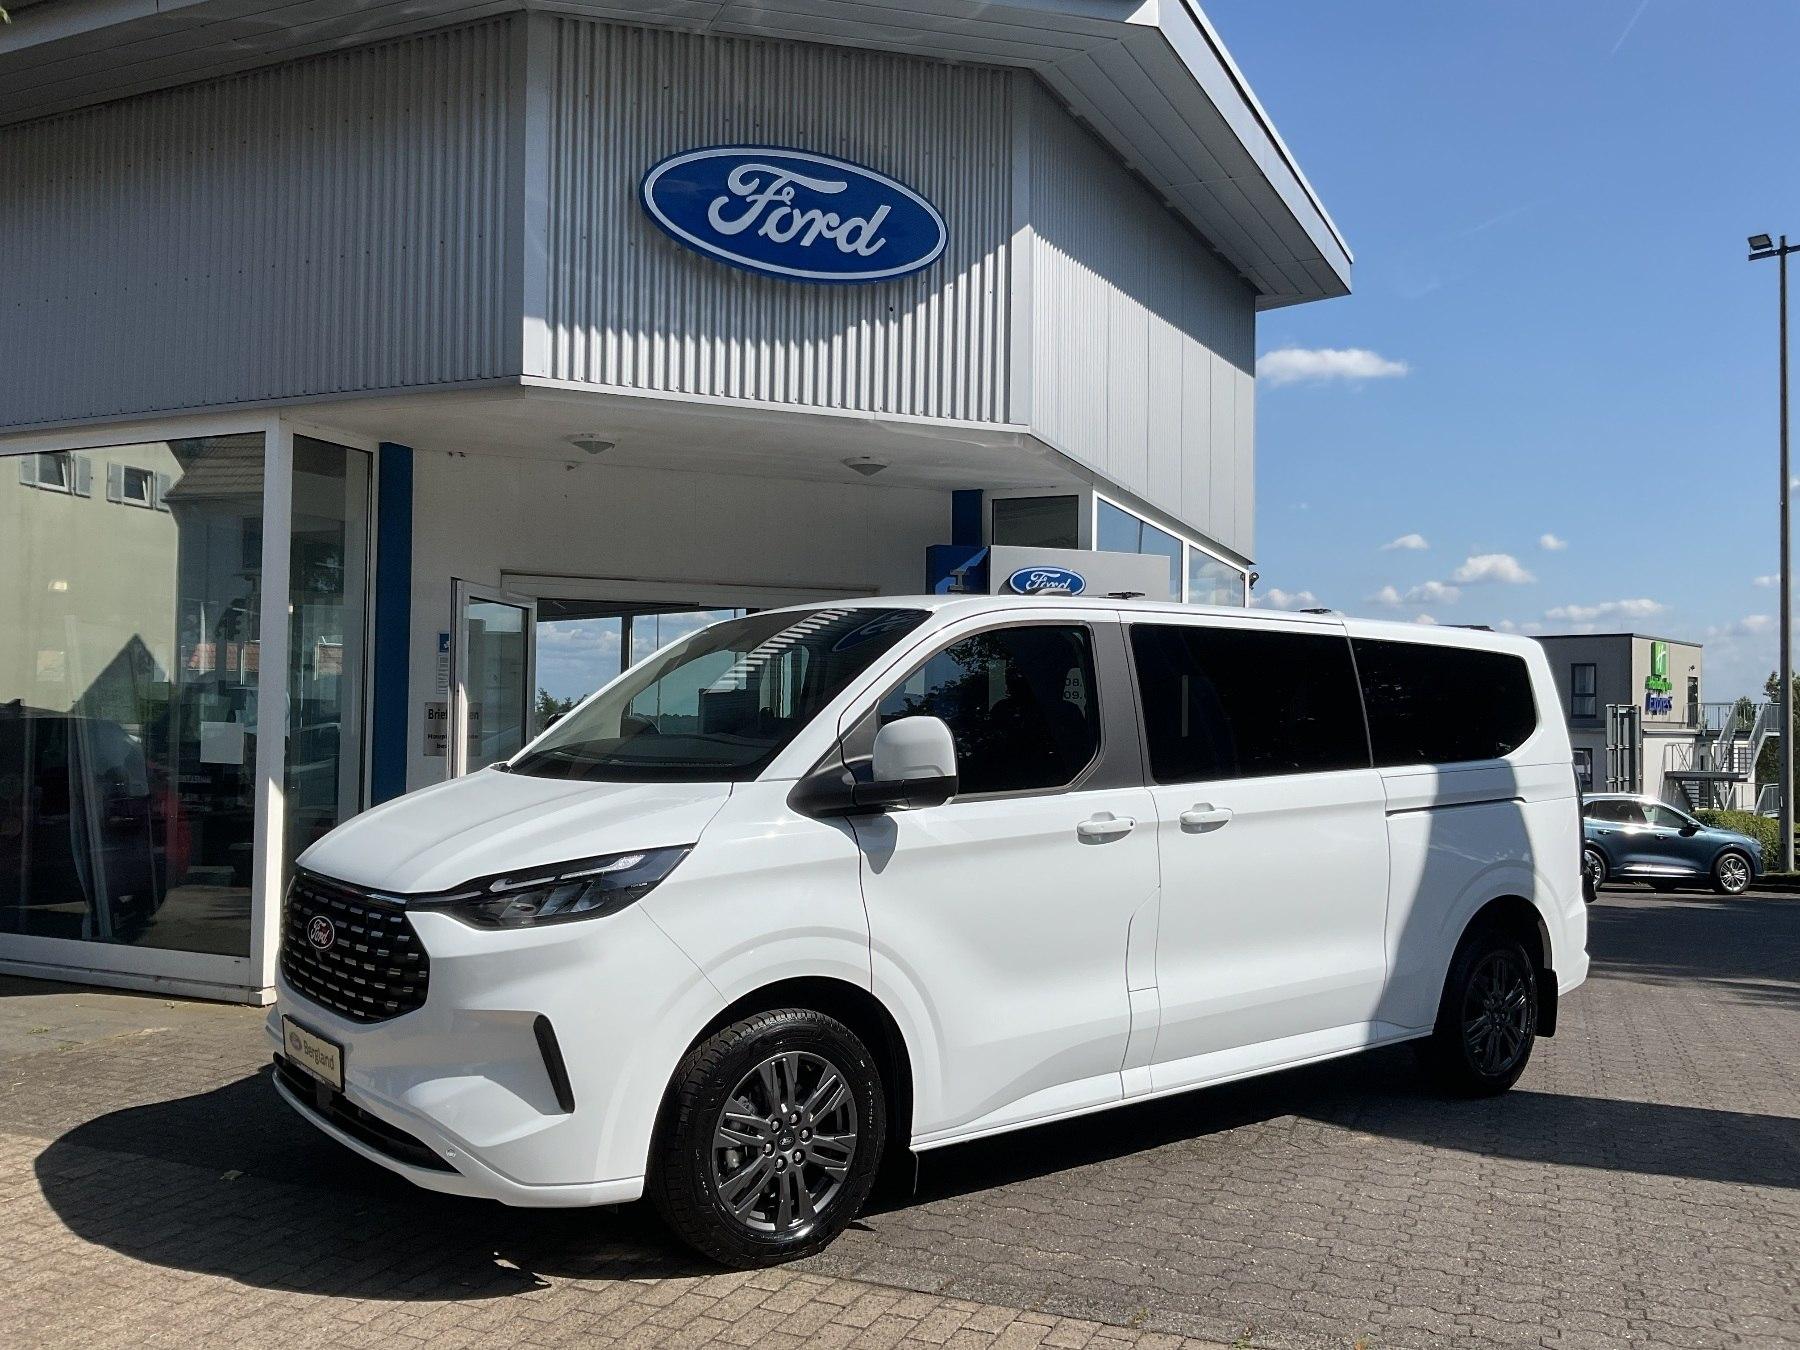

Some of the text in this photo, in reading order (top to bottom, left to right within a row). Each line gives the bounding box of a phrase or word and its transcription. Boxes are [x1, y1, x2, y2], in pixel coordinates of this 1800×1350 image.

[708, 163, 892, 257] Ford
[1026, 571, 1071, 590] Ford
[311, 919, 330, 945] Ford
